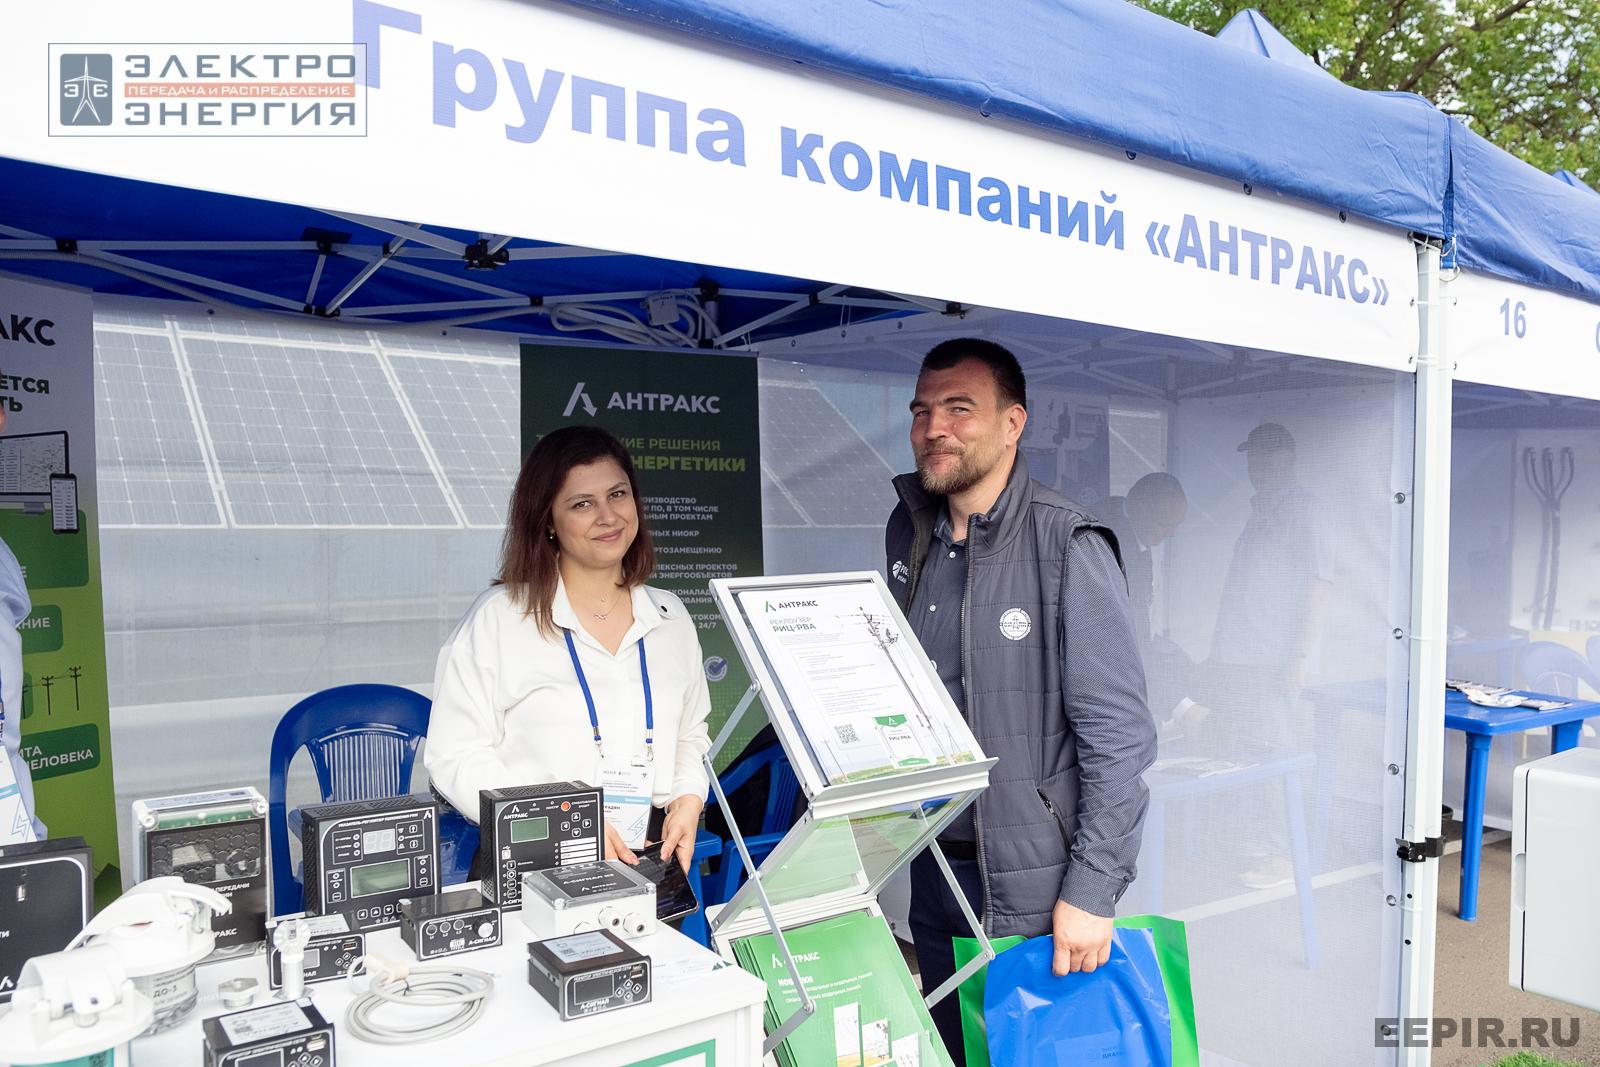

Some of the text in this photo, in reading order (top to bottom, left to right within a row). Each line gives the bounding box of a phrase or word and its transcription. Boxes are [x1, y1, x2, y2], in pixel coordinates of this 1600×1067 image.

[353, 0, 1390, 307] Группа компаний «АНТРАКС»
[1500, 298, 1527, 339] 16
[606, 391, 721, 414] АНТРАКС
[649, 438, 721, 451] РЕШЕНИЯ
[632, 455, 746, 472] НЕРГЕТИКИ
[642, 496, 697, 504] ОИЗВОДСТВО
[669, 513, 713, 521] ПРОЕКТАМ
[655, 546, 722, 554] РТОЗАМЕЩЕНИЮ
[655, 563, 738, 571] ЛЕКСНЫХ ПРОЕКТОВ
[778, 600, 819, 609] АНТРАКС
[699, 621, 717, 630] 24/7
[772, 623, 817, 632] РИЦ-РВА
[214, 928, 238, 938] РАКС
